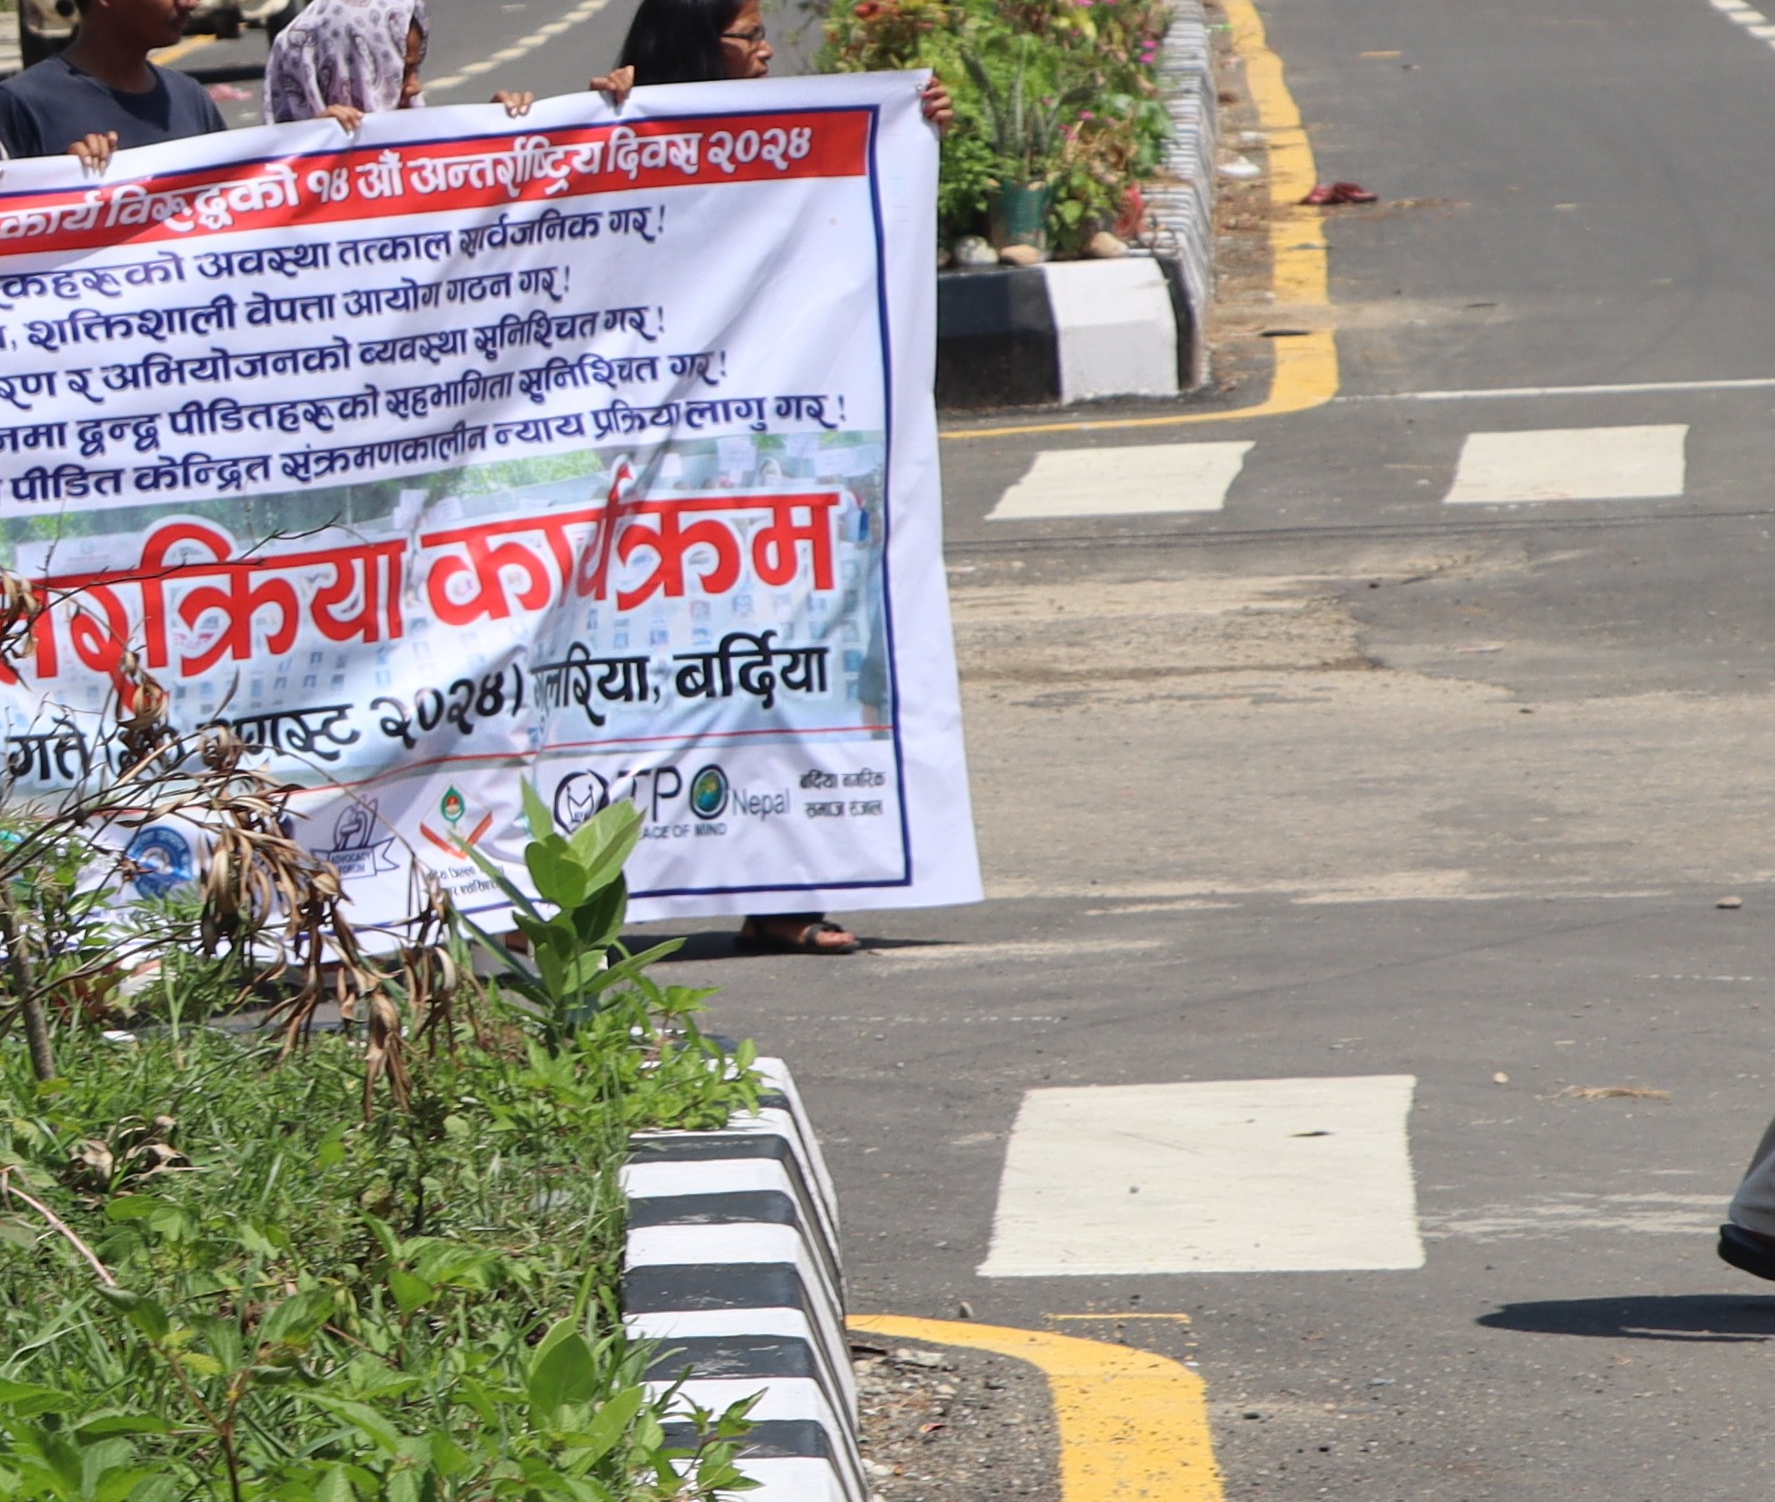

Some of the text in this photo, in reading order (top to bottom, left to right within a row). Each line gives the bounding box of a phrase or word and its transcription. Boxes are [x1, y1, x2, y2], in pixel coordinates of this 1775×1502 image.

[306, 167, 348, 205] १४
[605, 125, 700, 180] दिवस
[707, 126, 813, 173] २०२४
[197, 239, 331, 280] अवस्था
[337, 228, 451, 267] तत्काल
[459, 208, 604, 259] सार्वजनिक
[28, 291, 236, 354] शक्तिशाली
[344, 276, 441, 322] आयोग
[448, 272, 512, 305] गठन
[102, 335, 351, 393] अभियोजनको
[474, 309, 597, 361] सुनिश्चित
[77, 412, 162, 458] द्वन्द्व
[386, 367, 513, 421] सहभागिता
[519, 352, 659, 409] सुनिश्चित
[11, 459, 124, 505] पीडित
[134, 448, 270, 494] केन्द्रित
[280, 415, 487, 483] संक्रमणकालीन
[494, 411, 585, 446] न्याय
[591, 398, 680, 440] प्रक्रिया
[684, 397, 766, 433] लागु
[422, 466, 841, 622] कार्यक्रम
[673, 629, 830, 710] बर्दिया
[732, 787, 790, 823] Nepal
